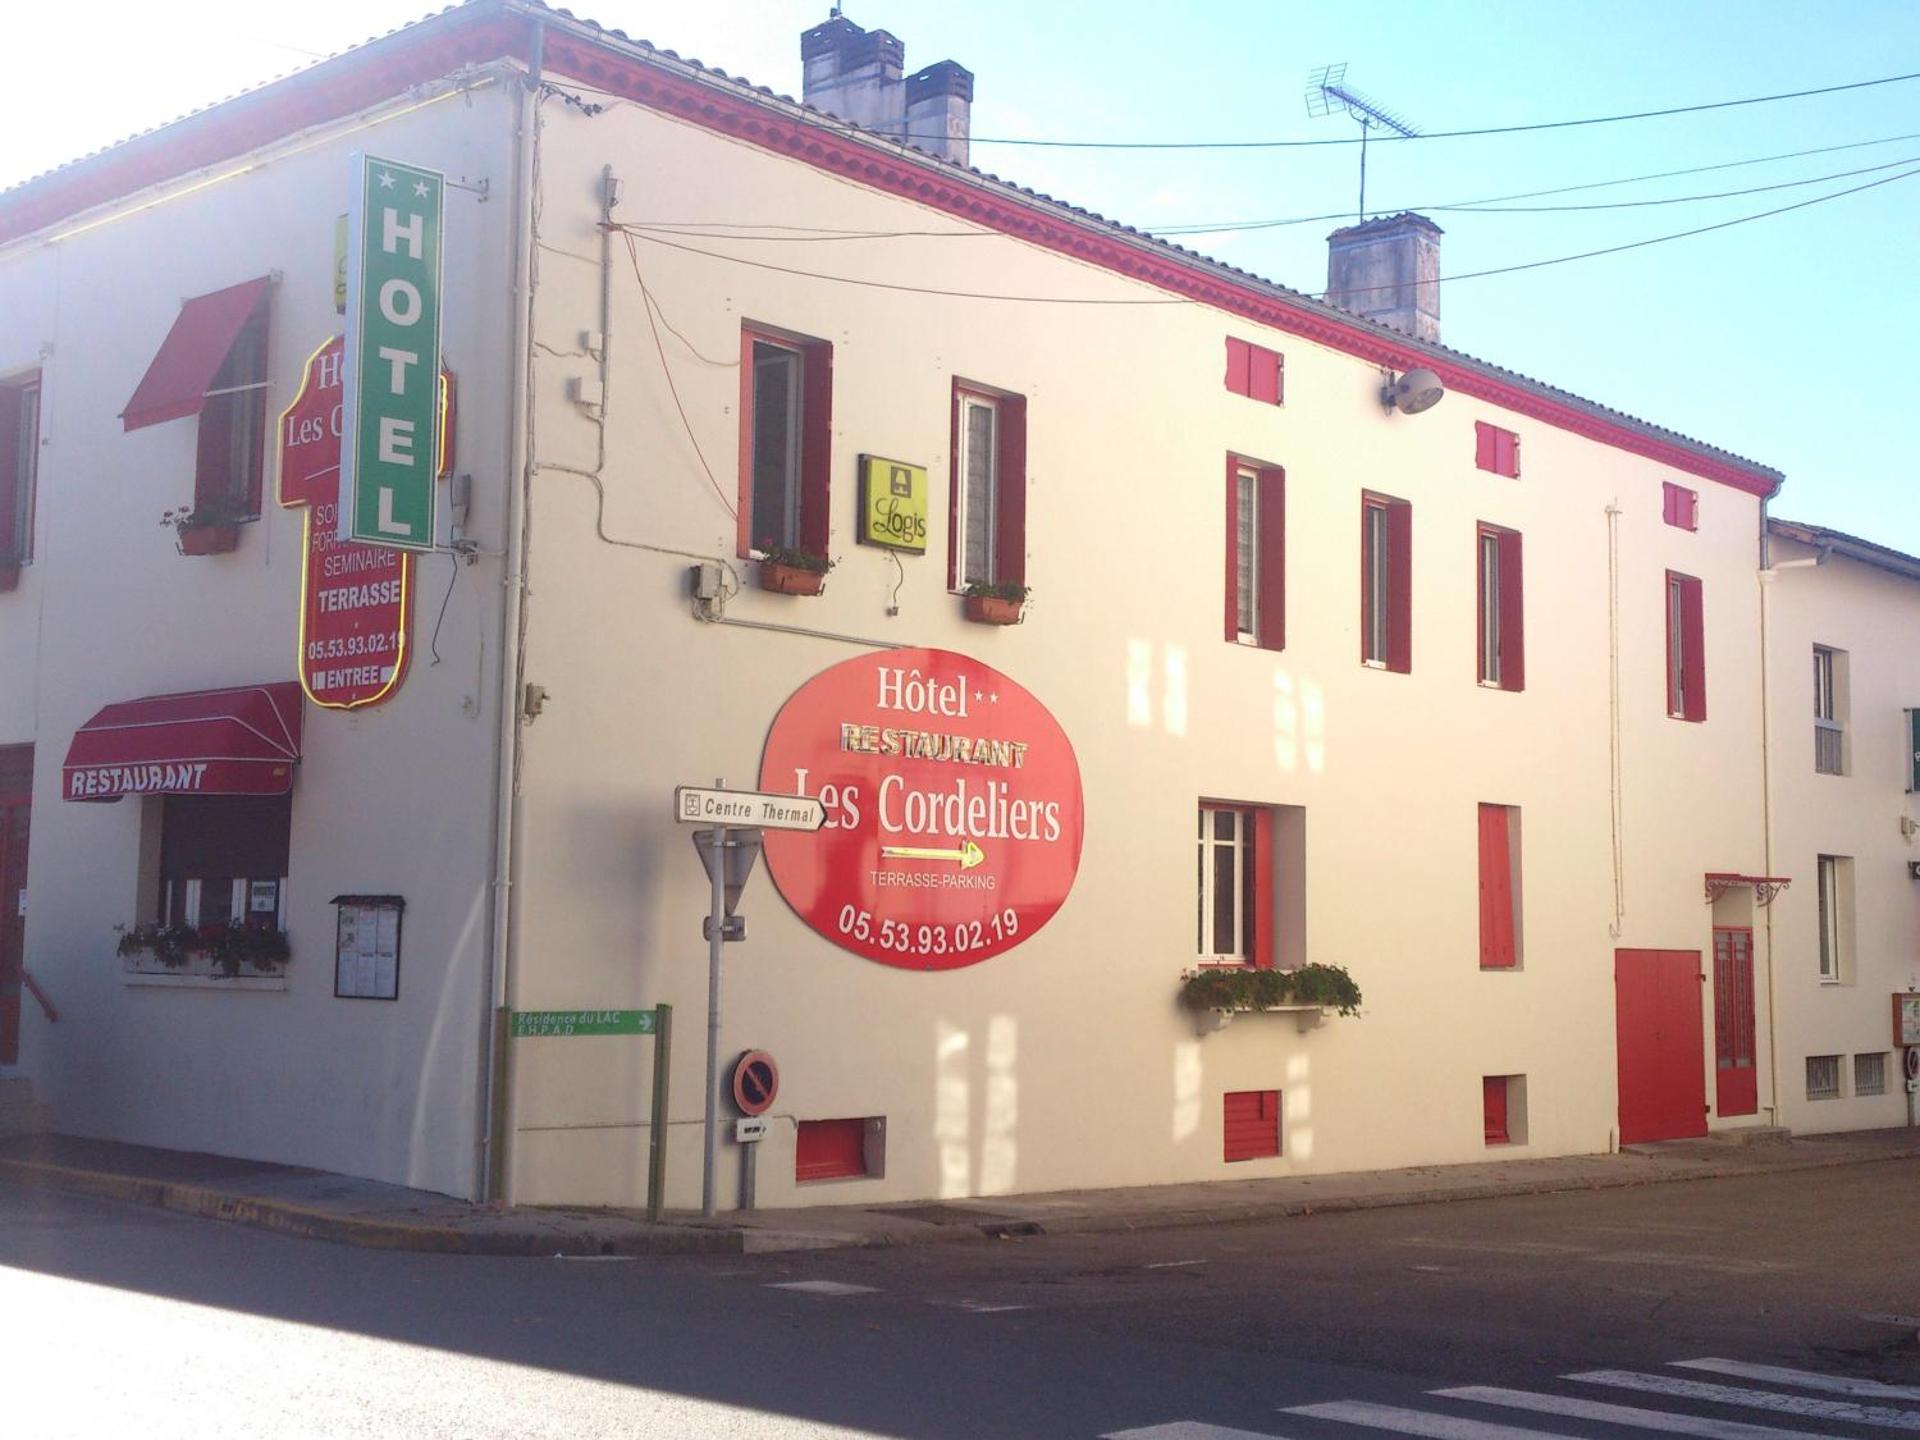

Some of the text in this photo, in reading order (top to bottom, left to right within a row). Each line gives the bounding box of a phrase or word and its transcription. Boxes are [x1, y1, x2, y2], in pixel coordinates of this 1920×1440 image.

[378, 207, 423, 535] HOTEL
[287, 415, 324, 446] Les
[873, 497, 926, 543] Logis
[324, 548, 396, 577] SEMINAIRE
[318, 580, 400, 613] TERRASSE
[327, 665, 380, 689] ENTREE
[877, 666, 968, 717] Hôtel
[840, 723, 1029, 769] RESTAURANT
[71, 763, 208, 797] RESTAURANT
[705, 798, 814, 822] Centre Thermal
[878, 774, 1061, 842] Cordeliers
[870, 871, 996, 890] TERRASSE-PARKING
[838, 904, 1019, 955] 05.53.93.02.19
